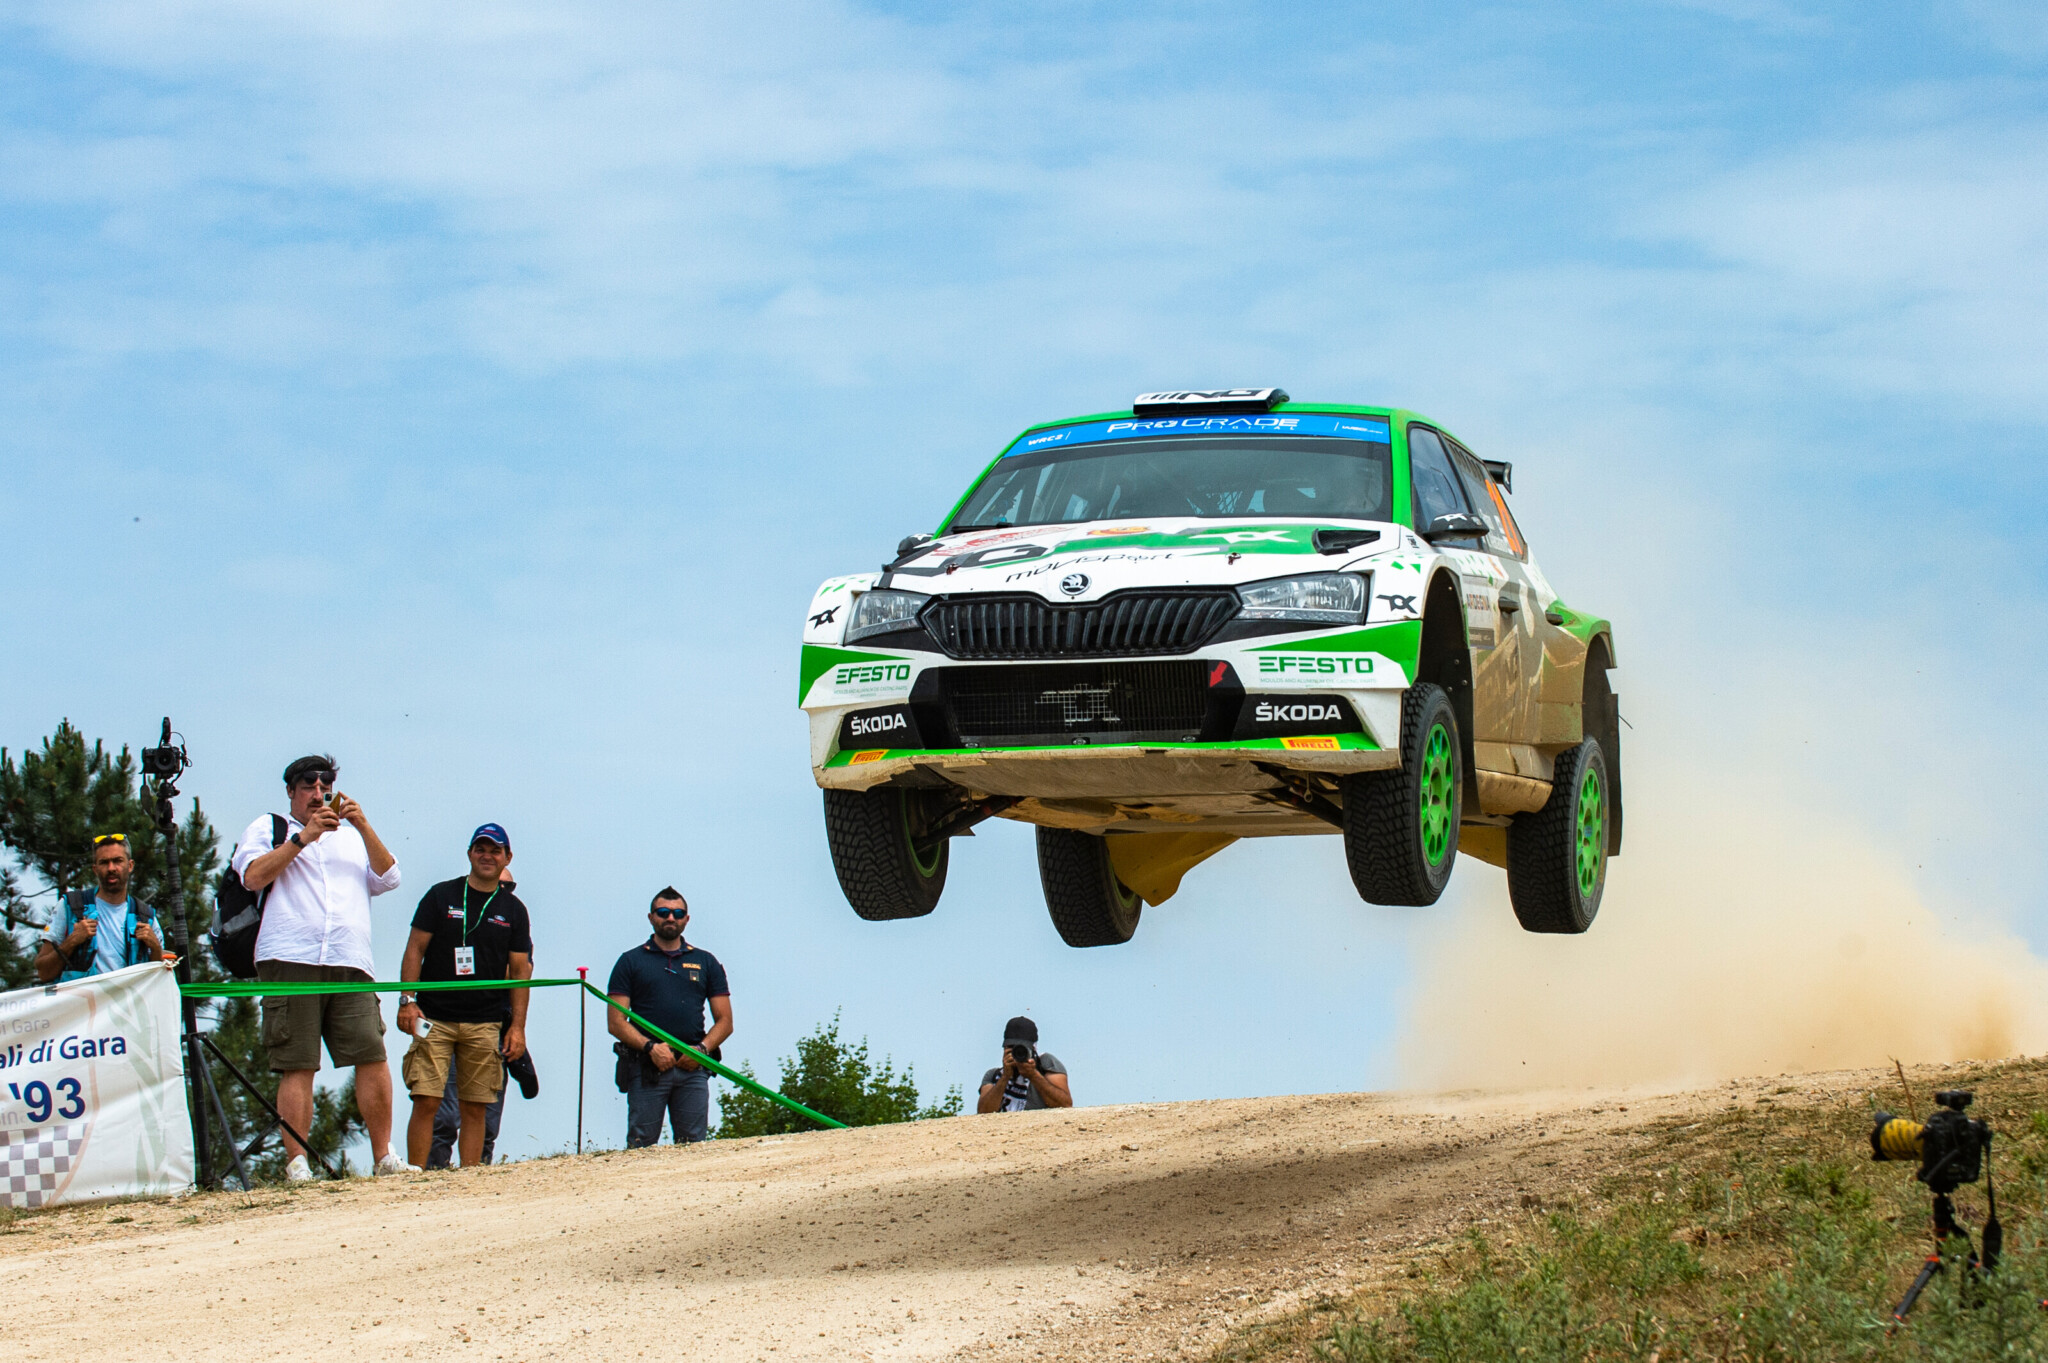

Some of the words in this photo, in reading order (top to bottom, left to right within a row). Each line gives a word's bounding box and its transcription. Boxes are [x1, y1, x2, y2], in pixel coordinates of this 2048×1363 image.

[1028, 433, 1064, 446] WRC2
[1258, 656, 1374, 674] EFESTO
[835, 664, 911, 685] EFESTO
[1255, 702, 1342, 722] ŠKODA
[850, 712, 908, 736] ŠKODA
[1287, 738, 1335, 749] PIRELLI
[853, 750, 885, 764] PIRELLI
[12, 1018, 50, 1034] Gara
[29, 1038, 55, 1064] di
[60, 1035, 127, 1060] Gara
